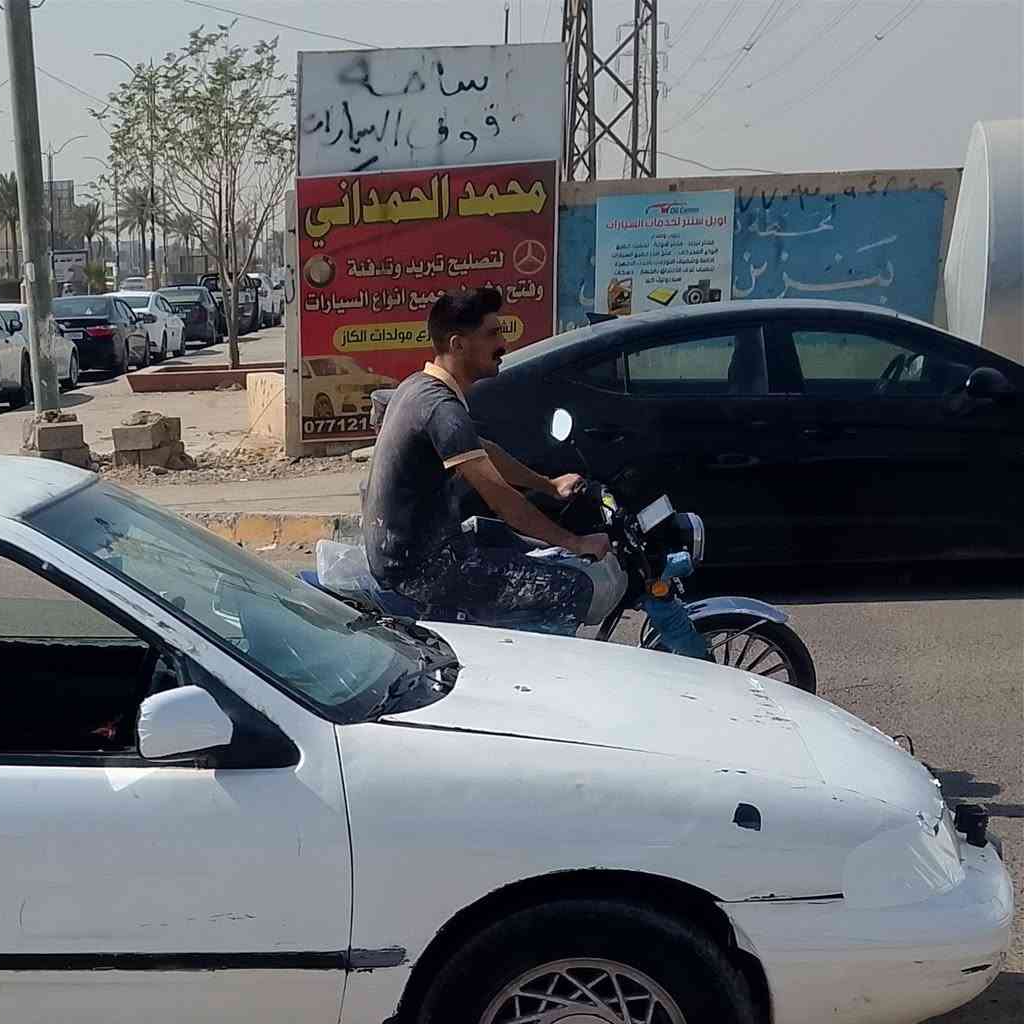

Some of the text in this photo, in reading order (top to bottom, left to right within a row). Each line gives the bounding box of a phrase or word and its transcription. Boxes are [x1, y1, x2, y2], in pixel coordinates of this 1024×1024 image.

[305, 174, 547, 248] محمد الحمداني
[406, 254, 445, 278] تبريد
[447, 251, 505, 278] لتصليح
[304, 289, 368, 314] السيارات
[372, 287, 406, 312] انواع
[370, 327, 413, 343] مولدات
[304, 416, 375, 434] 077121
